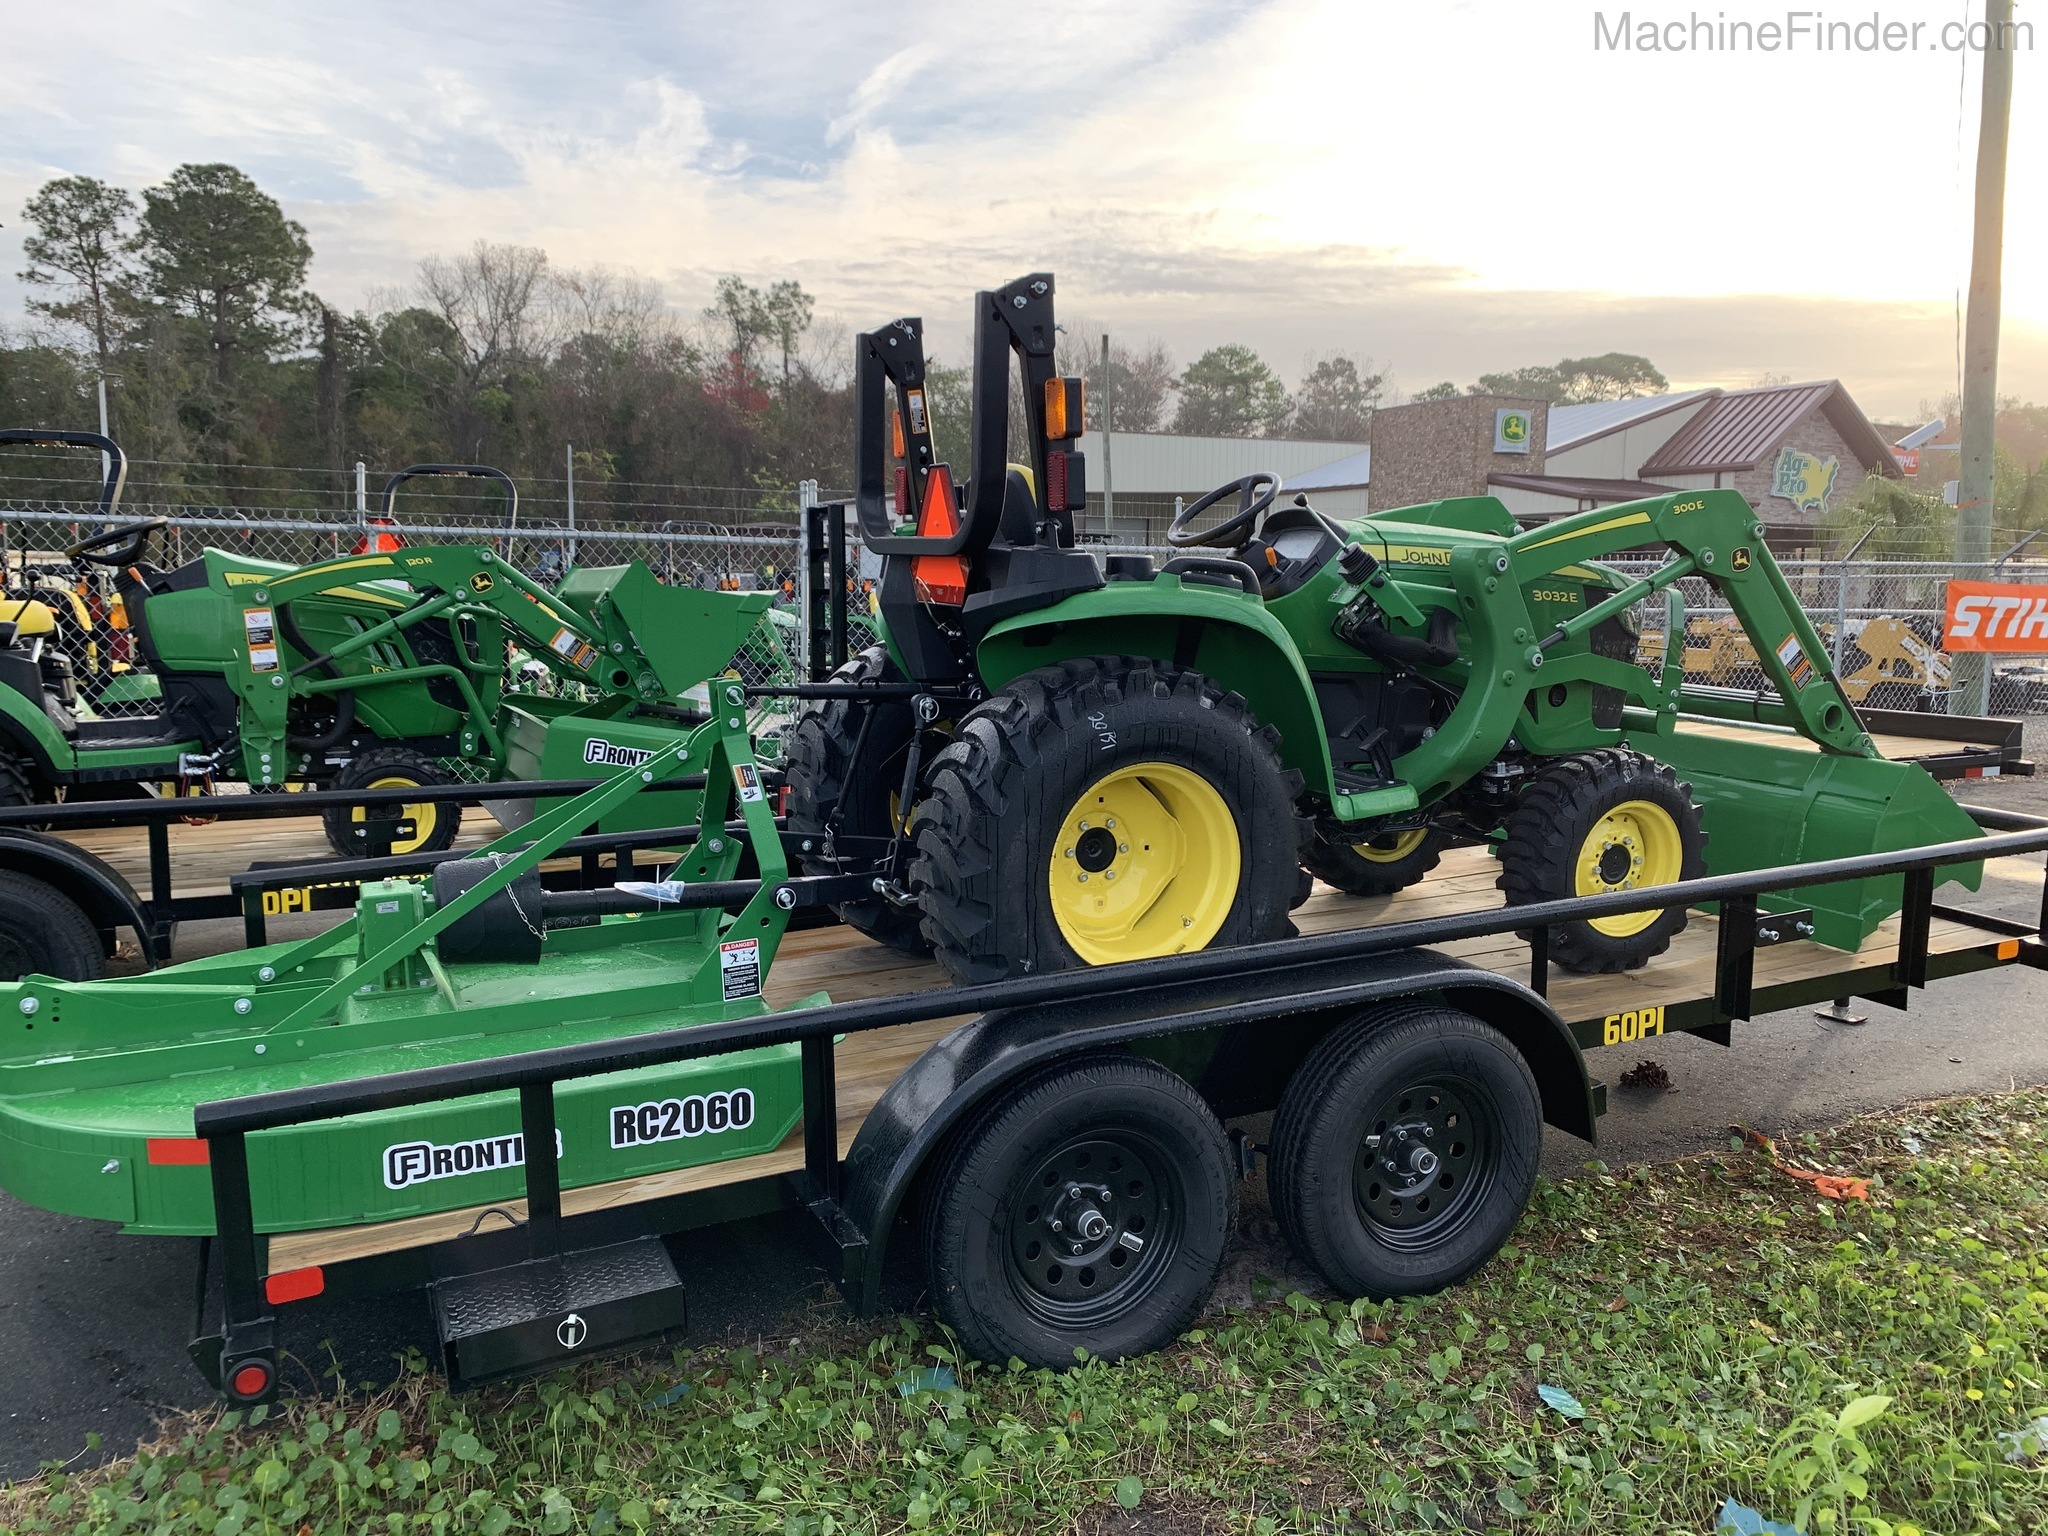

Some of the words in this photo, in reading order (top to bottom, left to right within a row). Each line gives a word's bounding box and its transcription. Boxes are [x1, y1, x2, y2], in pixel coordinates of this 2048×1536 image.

[1777, 472, 1807, 493] Pro
[1401, 549, 1443, 564] JOHN
[1532, 590, 1578, 603] 3032E
[1949, 595, 2048, 639] STIH
[585, 739, 658, 767] FRONT
[613, 1091, 752, 1145] RC2060
[388, 1134, 558, 1186] FRONTI
